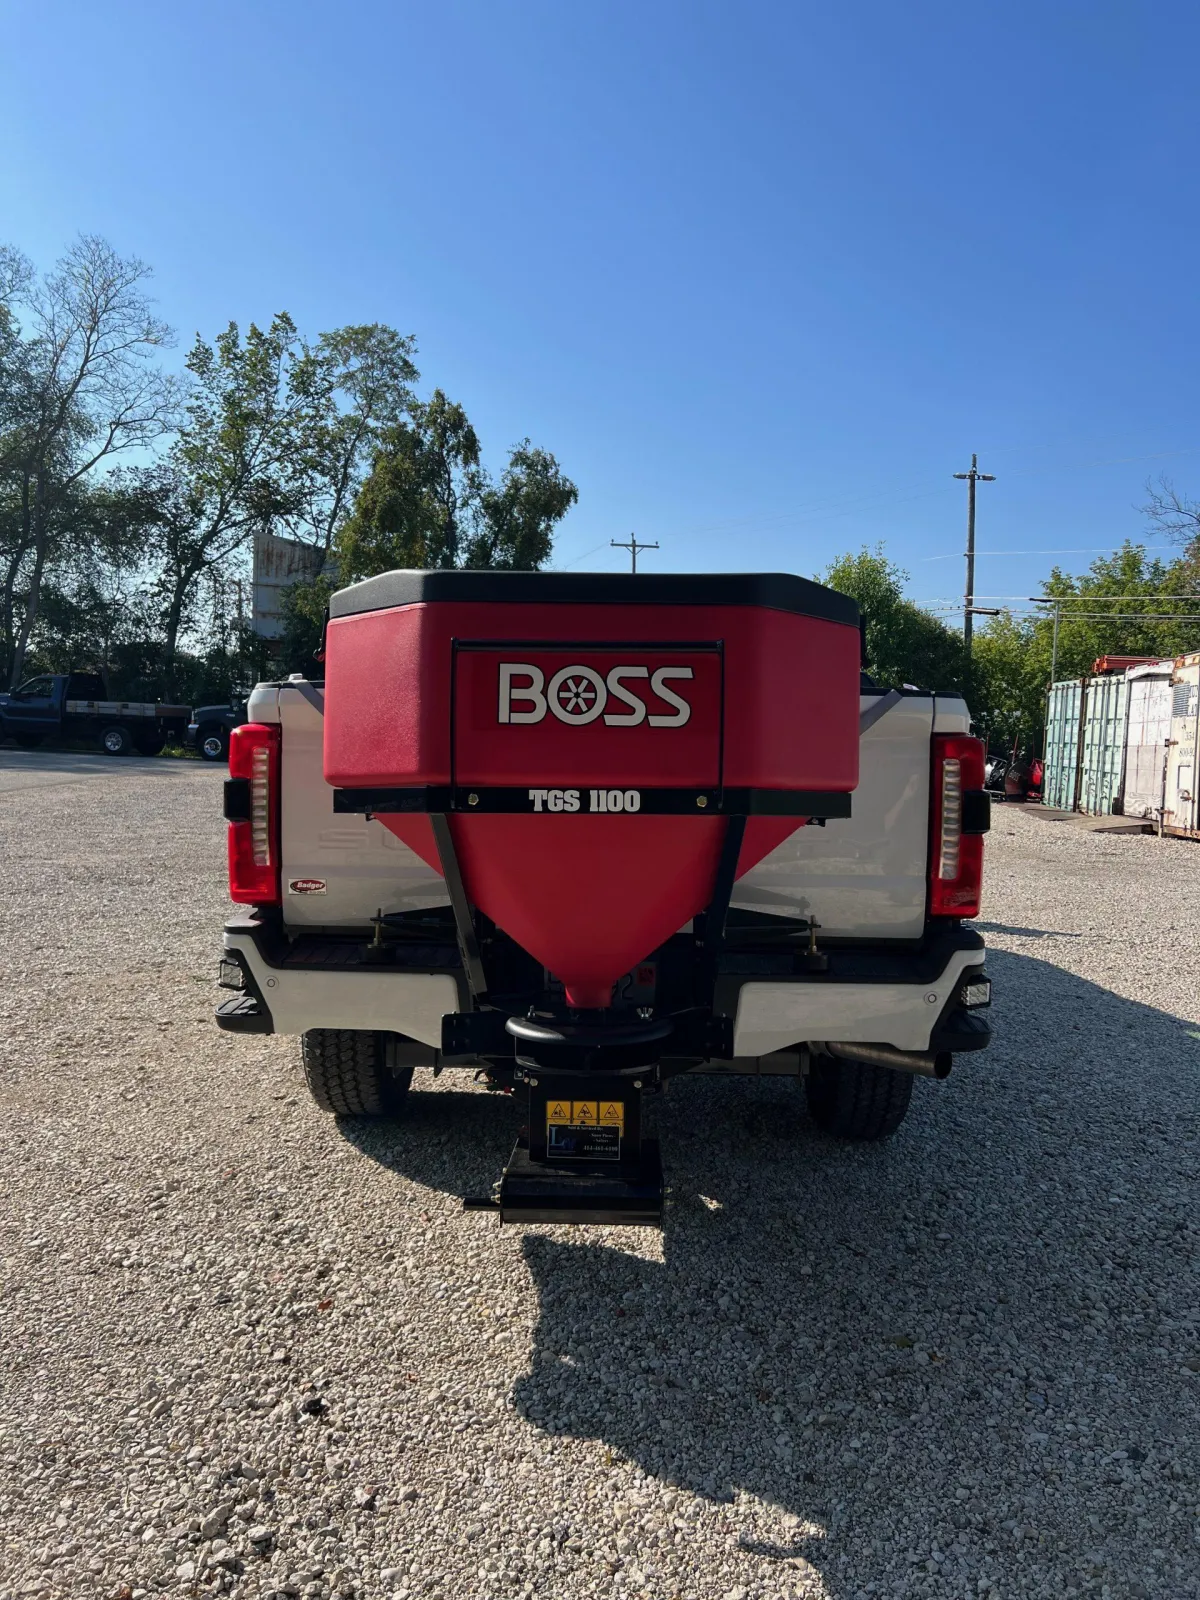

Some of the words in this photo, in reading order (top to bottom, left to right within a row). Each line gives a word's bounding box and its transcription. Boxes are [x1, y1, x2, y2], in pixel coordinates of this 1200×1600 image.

[498, 662, 694, 728] BOSS
[528, 789, 581, 812] TGS
[589, 789, 641, 812] 1100
[297, 881, 324, 890] Badger
